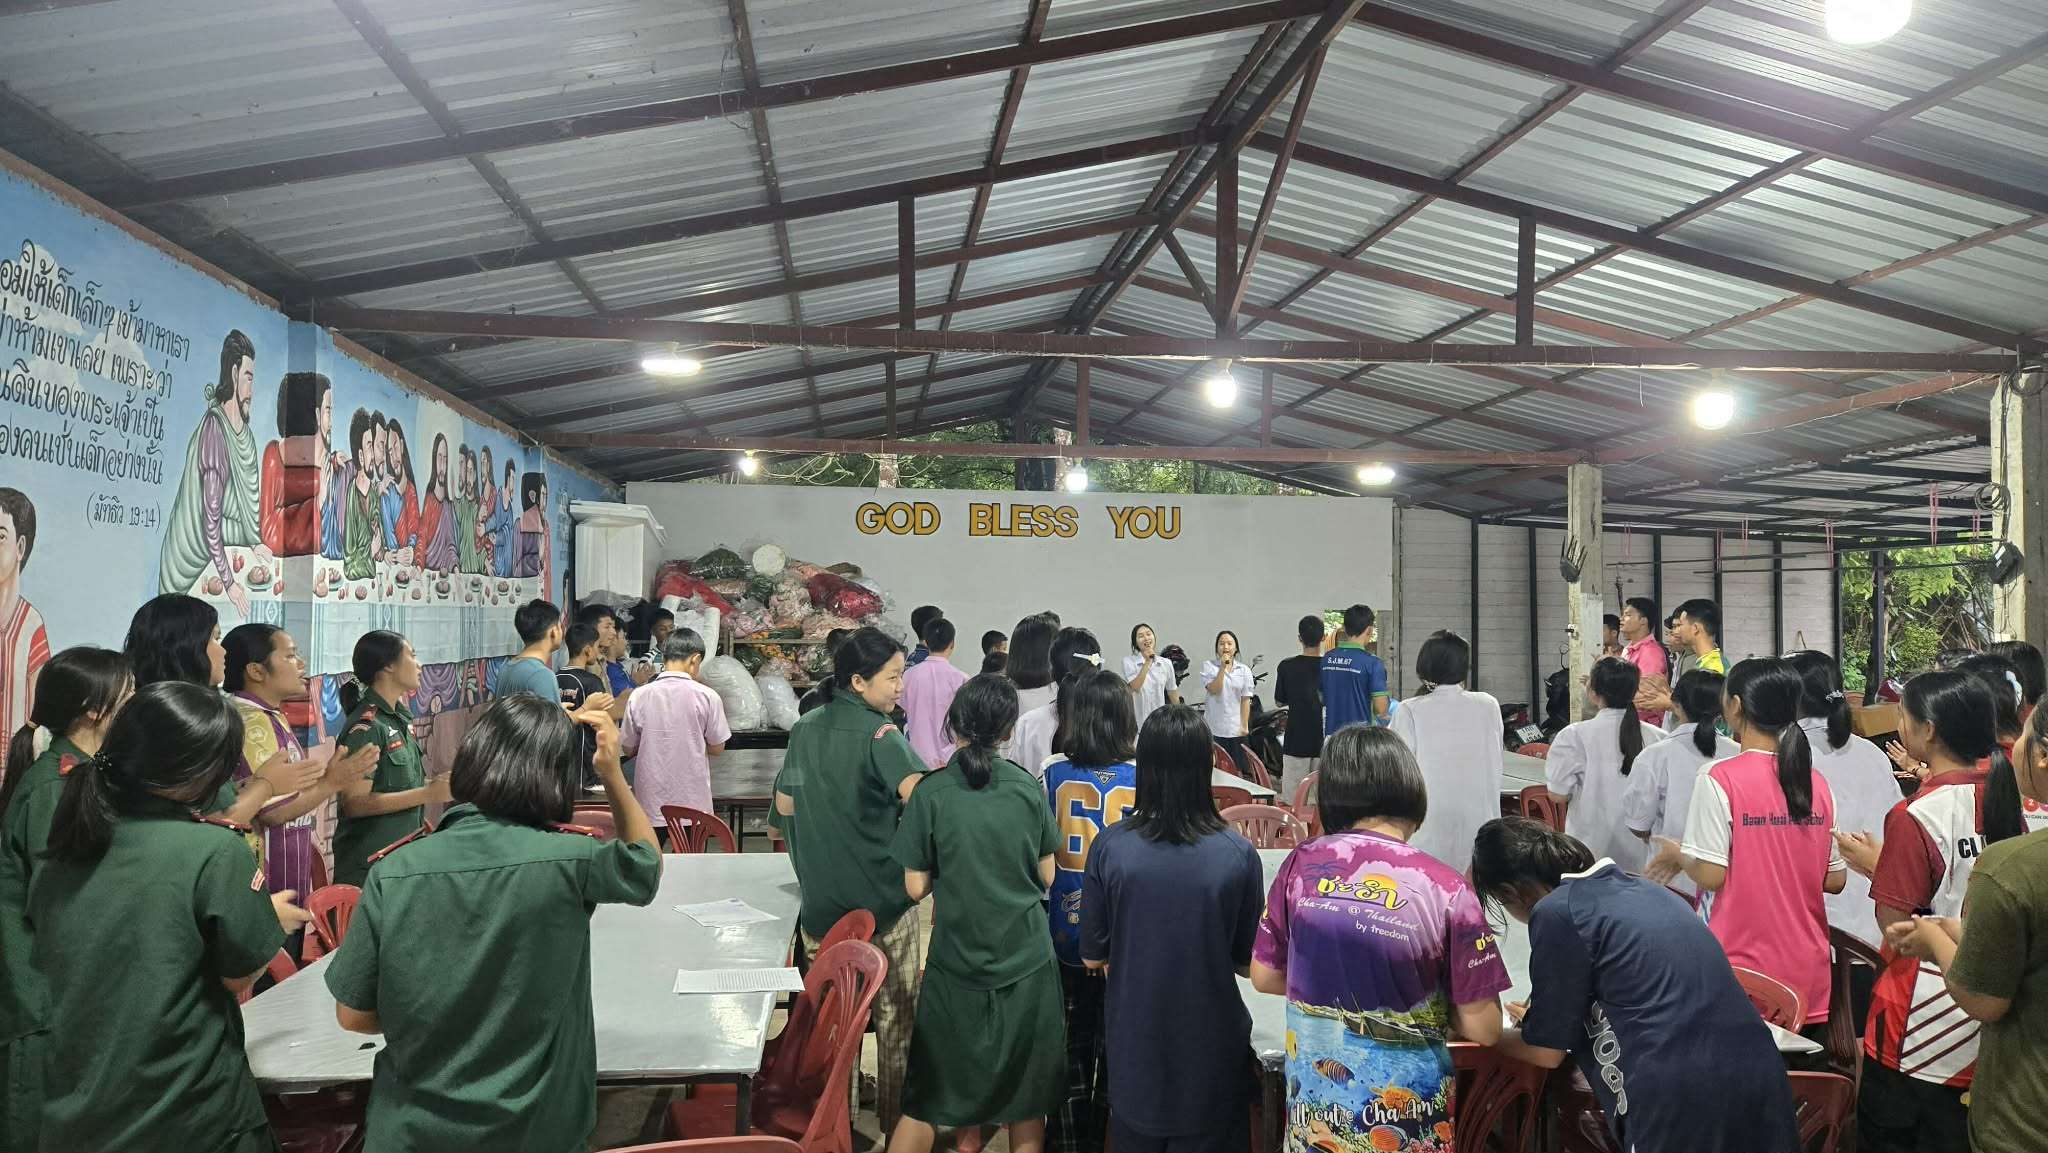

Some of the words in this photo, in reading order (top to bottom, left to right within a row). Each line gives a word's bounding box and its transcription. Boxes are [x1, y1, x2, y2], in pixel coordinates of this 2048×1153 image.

[855, 502, 941, 535] GOD
[969, 502, 1079, 538] BLESS
[1106, 505, 1181, 539] YOU
[1297, 897, 1341, 912] Cha-Am
[1364, 908, 1419, 931] Thailand
[1356, 920, 1367, 933] by
[1370, 924, 1409, 941] freedom
[1362, 1100, 1400, 1126] Cha
[1405, 1098, 1434, 1119] Am
